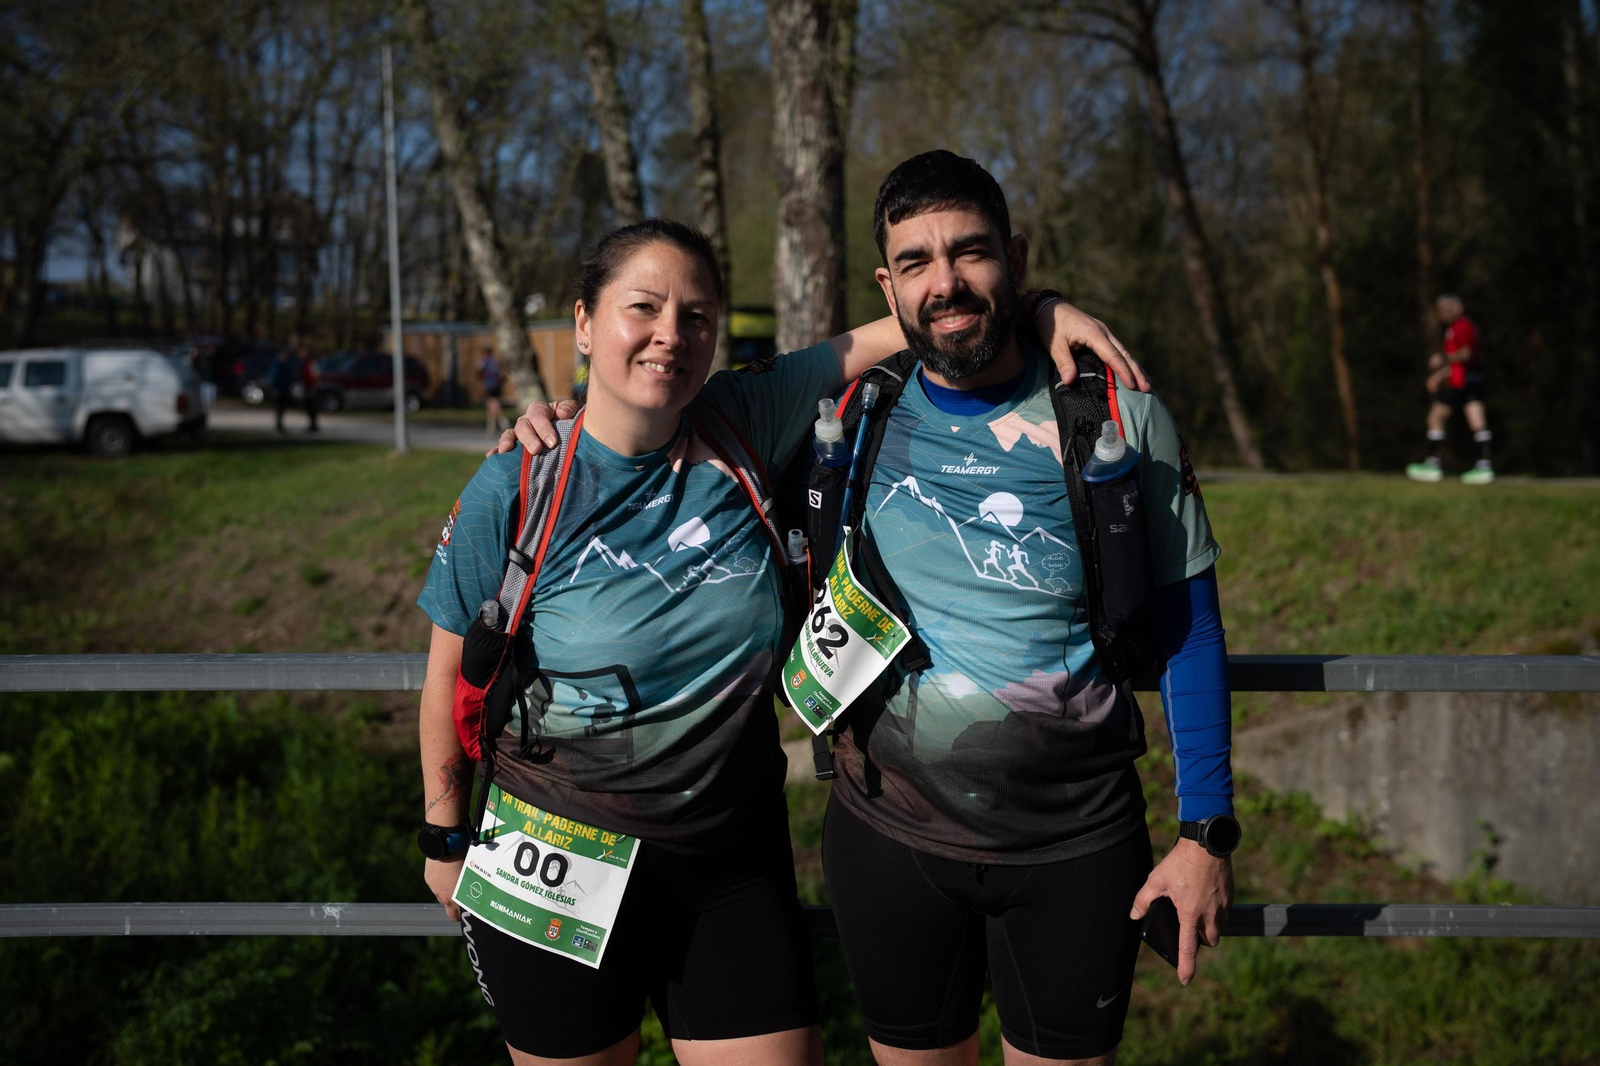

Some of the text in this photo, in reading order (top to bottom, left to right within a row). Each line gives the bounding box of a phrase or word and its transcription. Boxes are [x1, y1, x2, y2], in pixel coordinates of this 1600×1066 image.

[941, 465, 1000, 475] TEAMERGY
[830, 575, 855, 620] ALLARIZ
[841, 577, 881, 622] PADERNE
[877, 616, 894, 634] DE
[807, 640, 834, 678] VILLANUEVA
[514, 798, 539, 821] TRAIL
[543, 813, 599, 841] PADERNE
[601, 830, 617, 847] DE
[522, 821, 574, 850] ALLARIZ
[514, 841, 569, 887] 00
[496, 867, 577, 906] SANDRA GÓMEZ IGLESIAS
